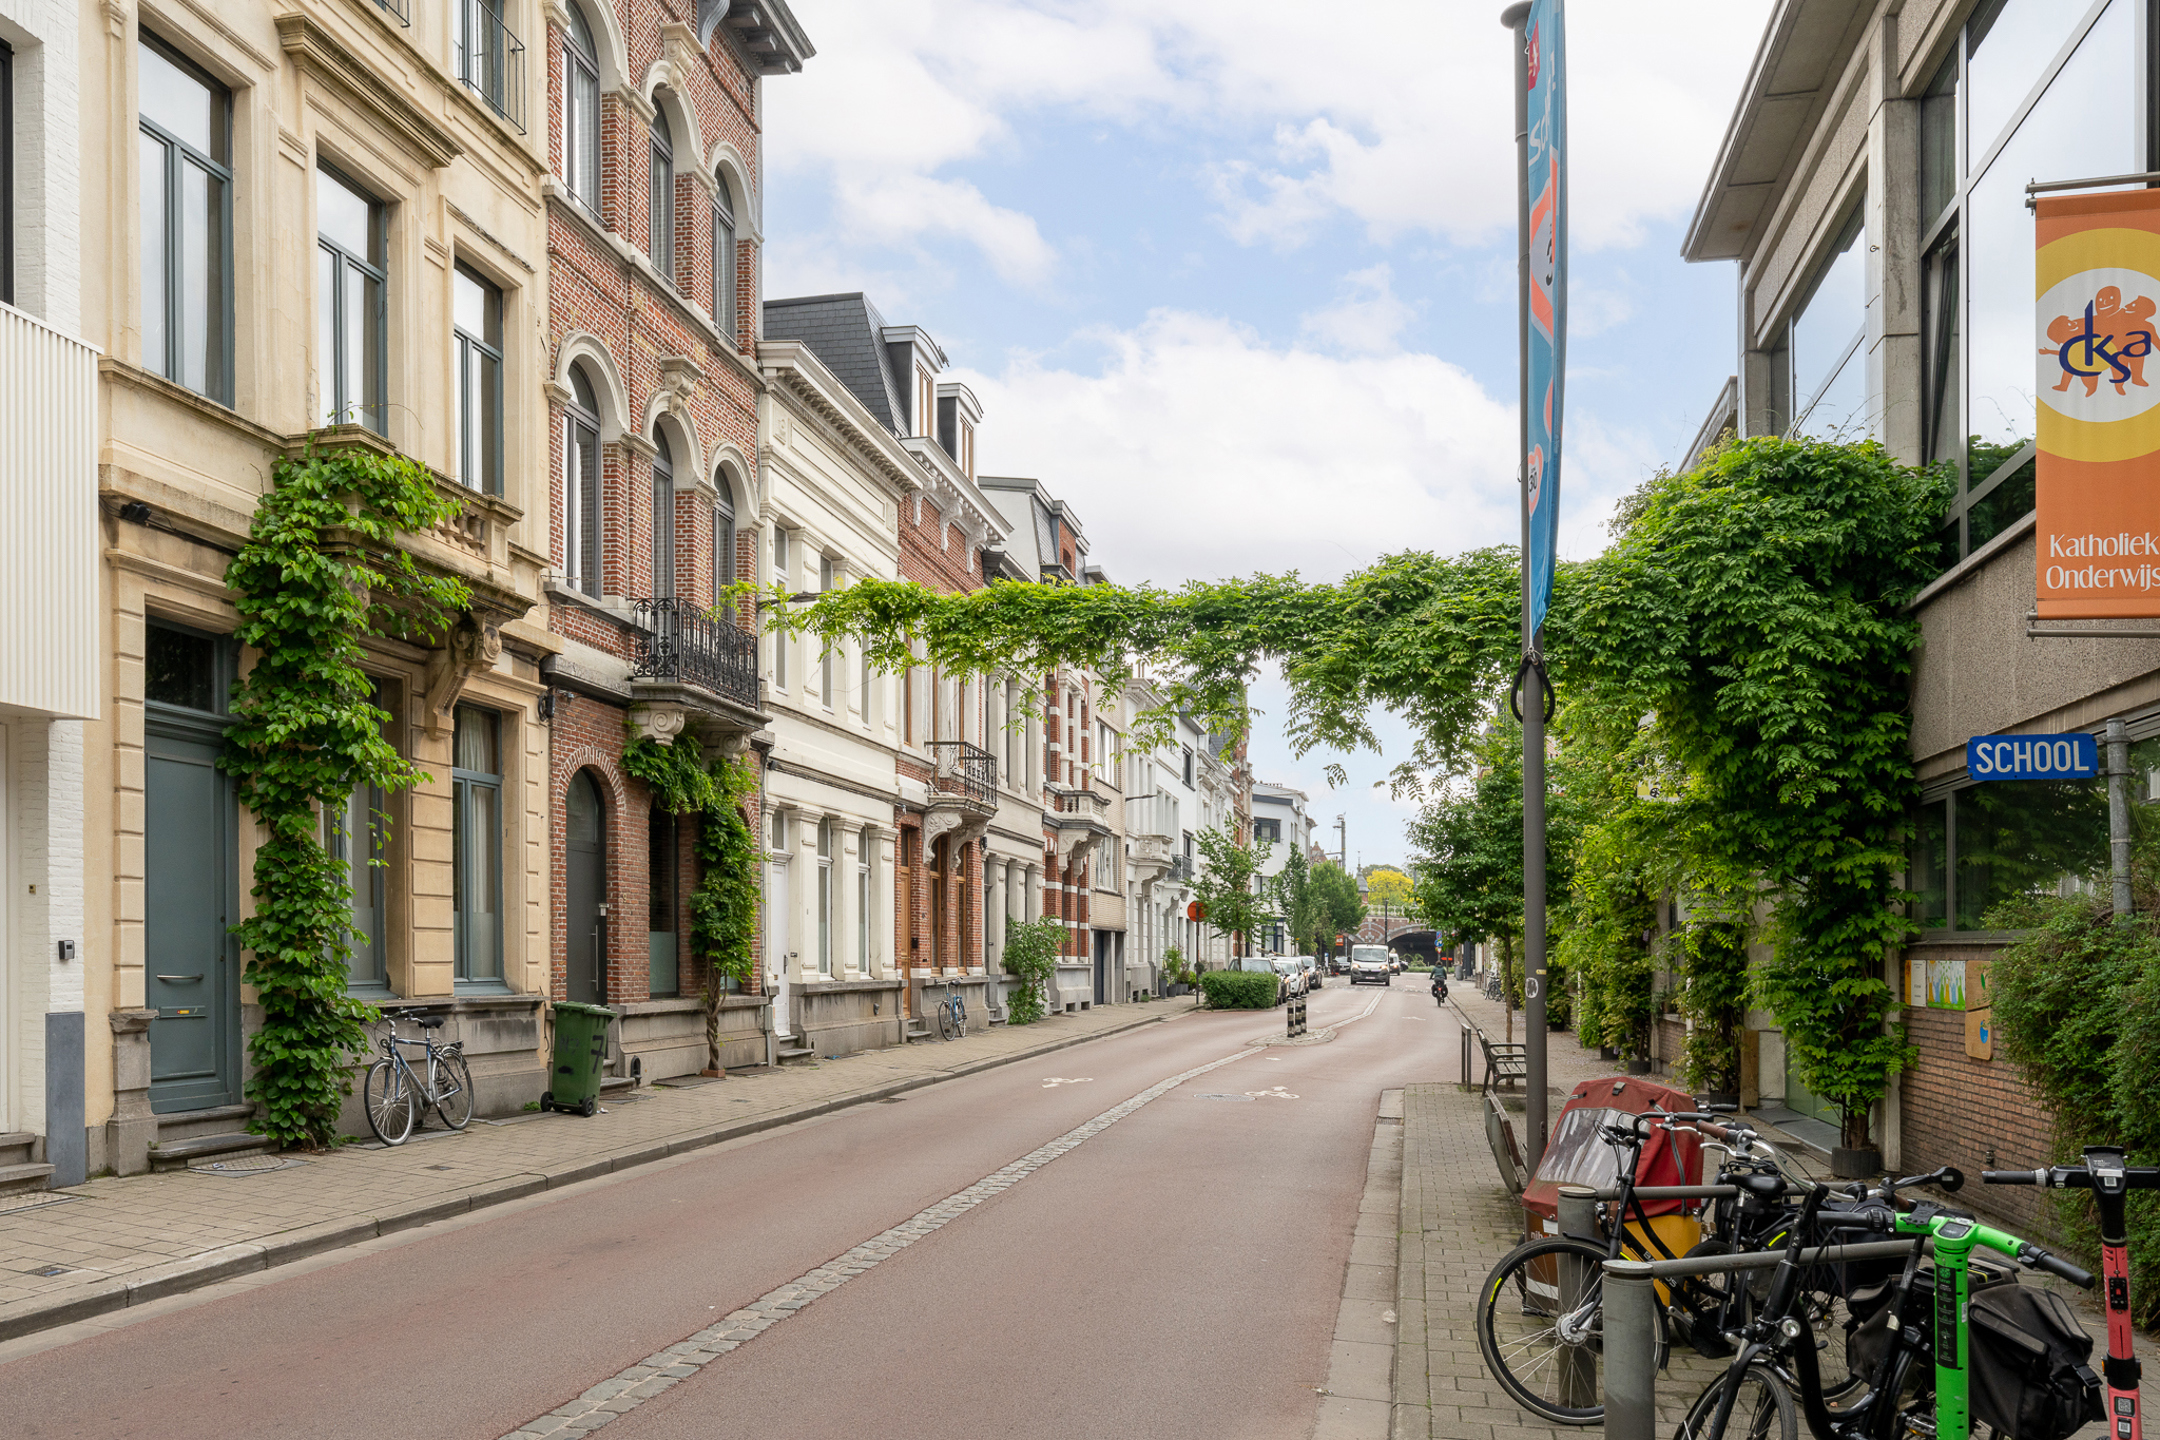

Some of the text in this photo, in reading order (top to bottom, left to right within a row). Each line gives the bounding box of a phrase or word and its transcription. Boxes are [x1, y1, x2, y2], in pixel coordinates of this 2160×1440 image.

[2050, 532, 2160, 557] Katholiek
[2046, 564, 2160, 592] Onderwijs
[1976, 741, 2089, 773] SCHOOL
